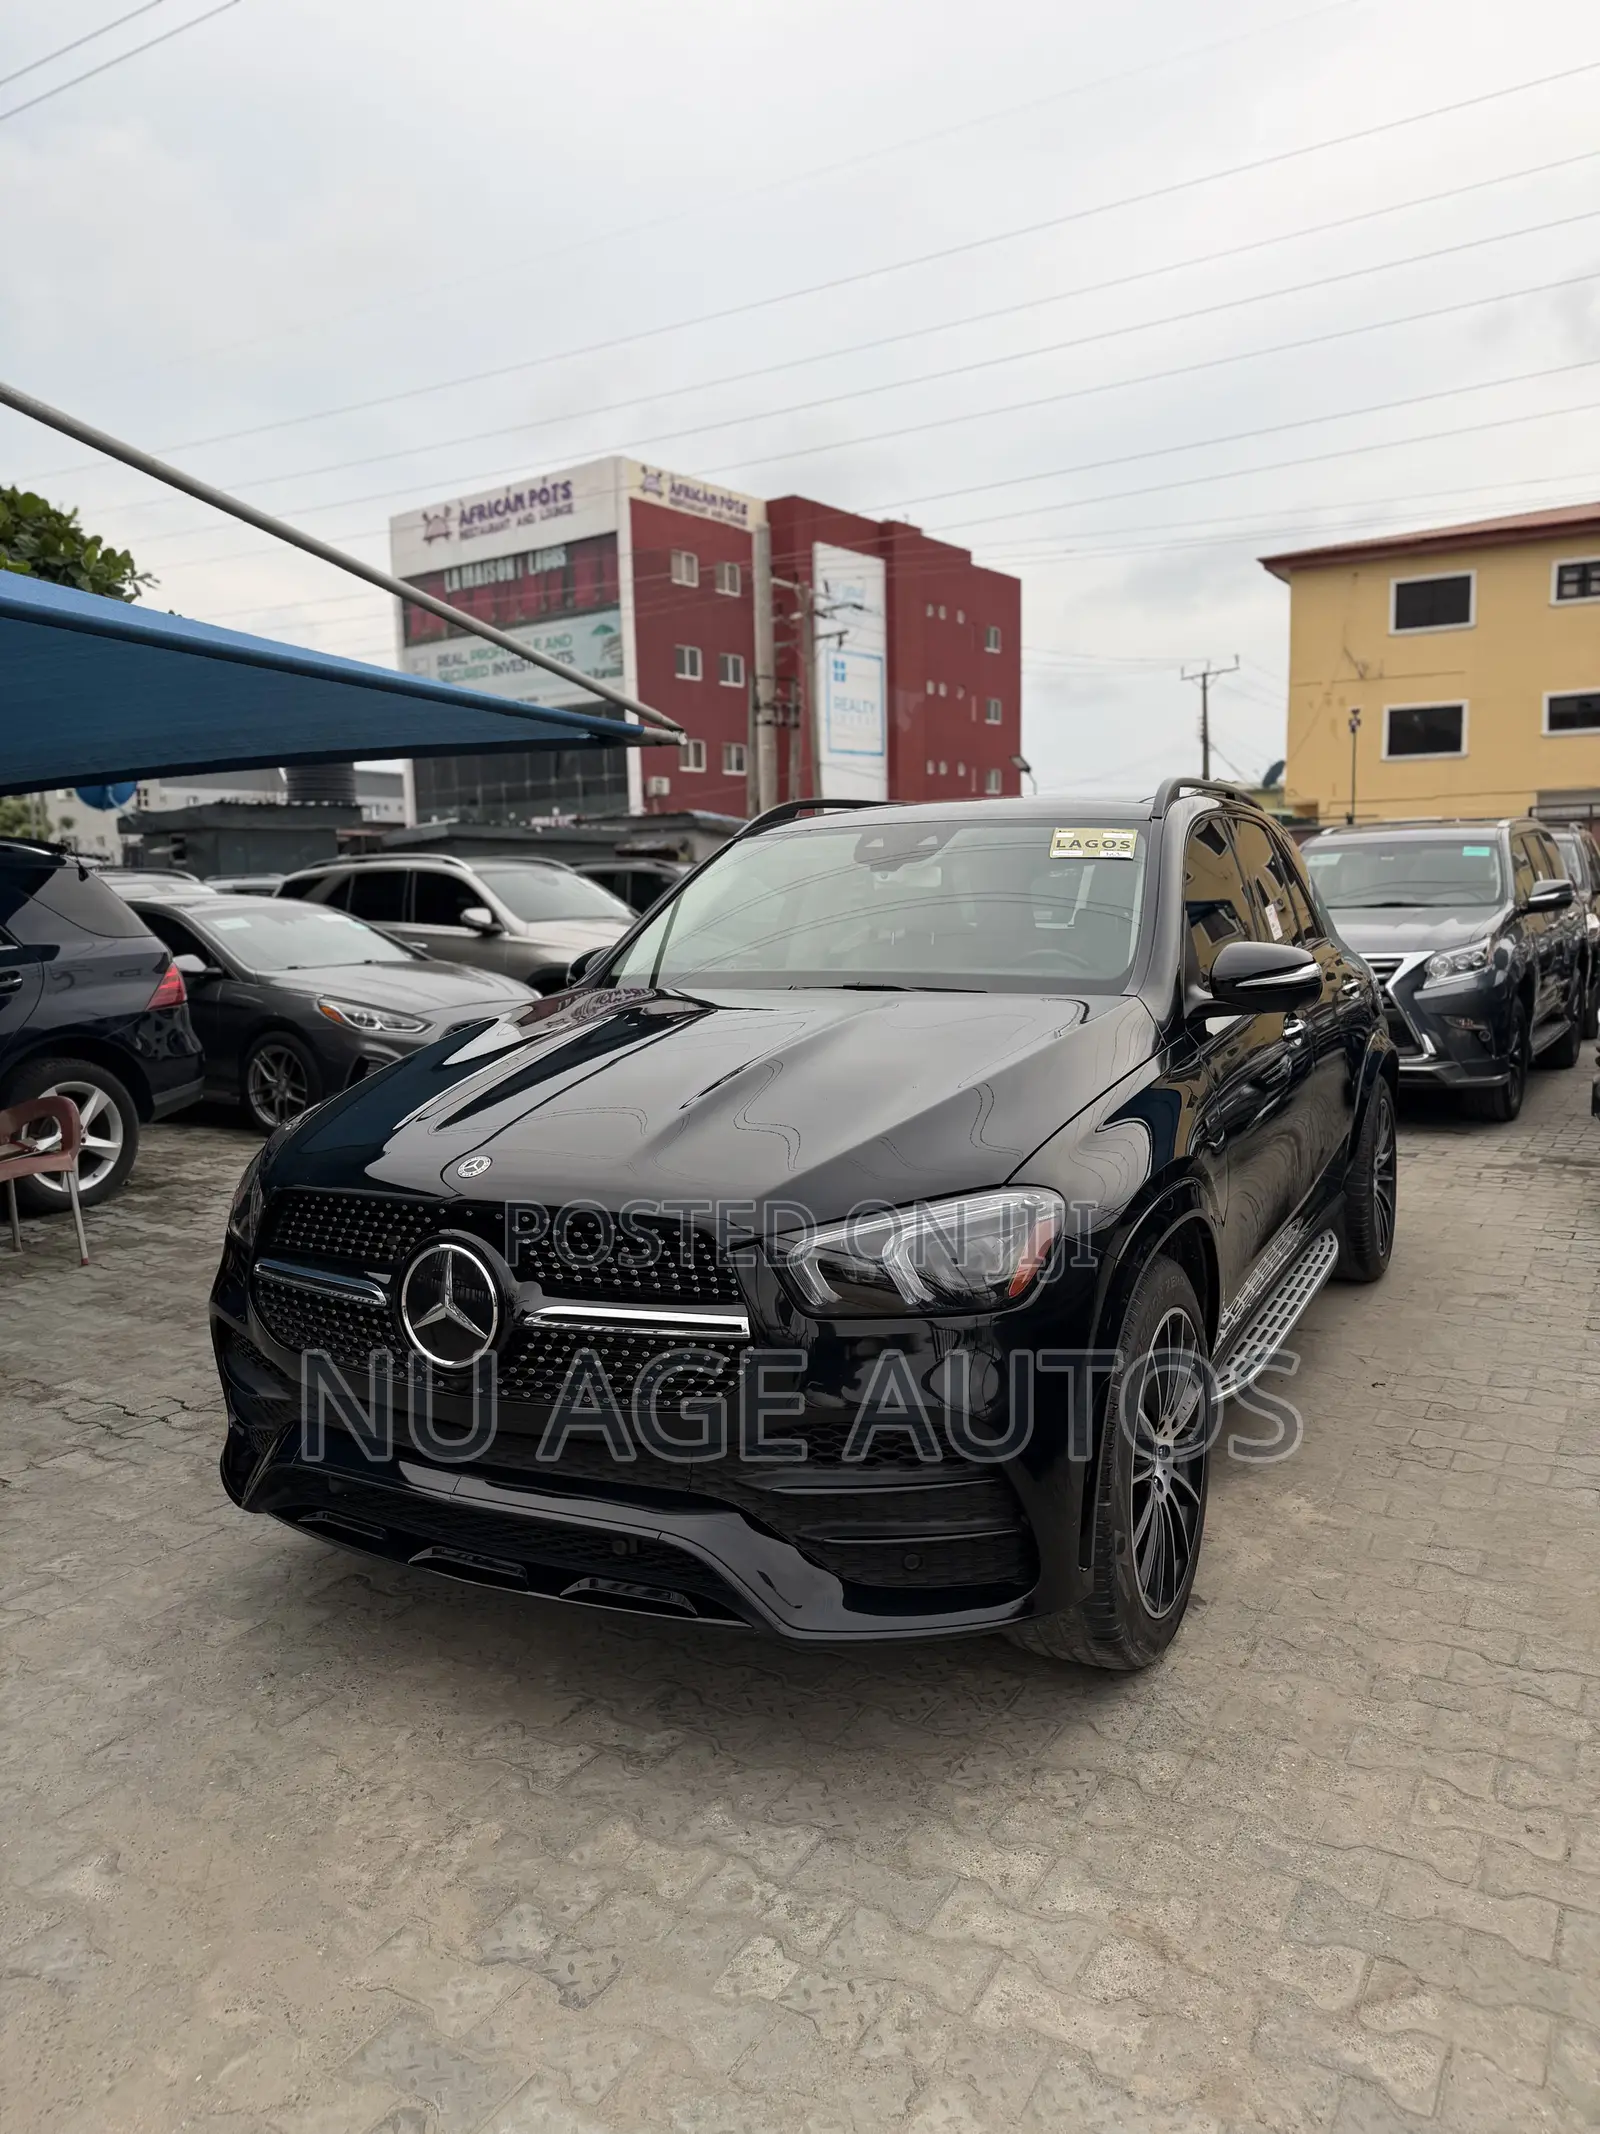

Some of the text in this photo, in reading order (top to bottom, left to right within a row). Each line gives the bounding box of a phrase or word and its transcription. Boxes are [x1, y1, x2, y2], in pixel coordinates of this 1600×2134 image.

[459, 480, 572, 527] AFRICAN POTS
[1055, 839, 1131, 849] LAGOS
